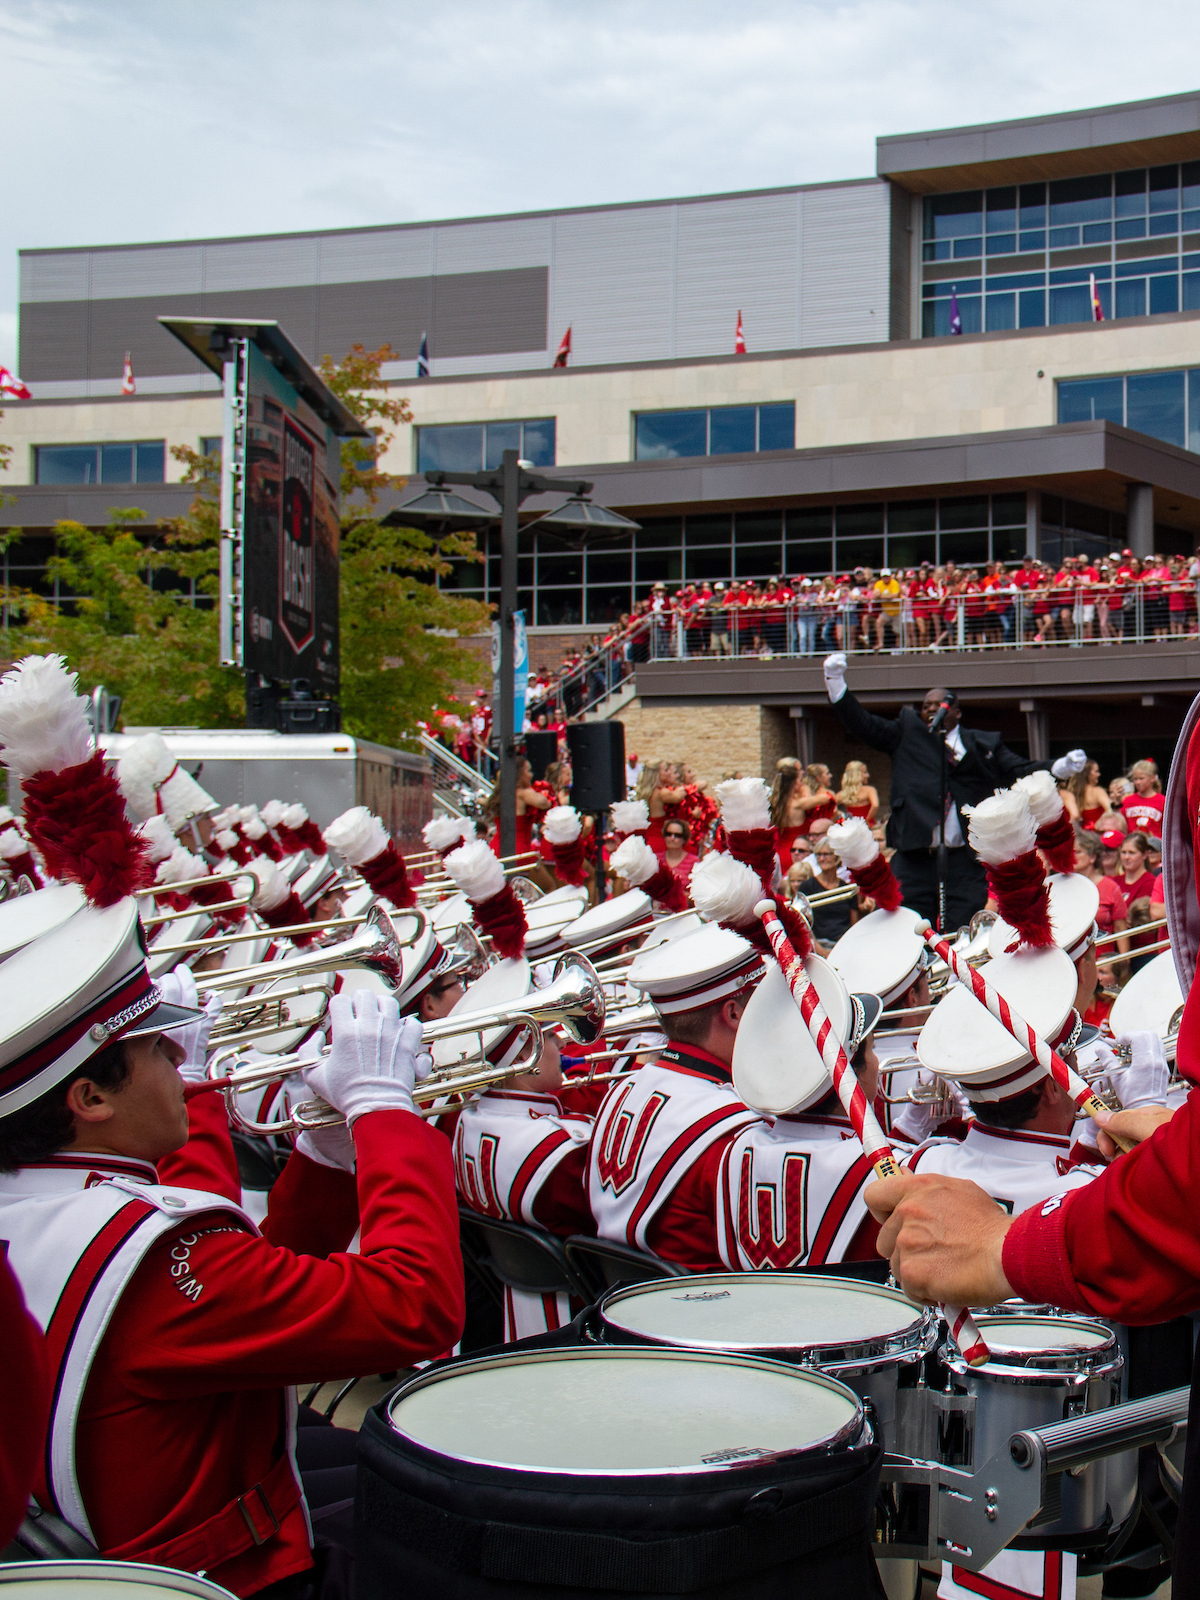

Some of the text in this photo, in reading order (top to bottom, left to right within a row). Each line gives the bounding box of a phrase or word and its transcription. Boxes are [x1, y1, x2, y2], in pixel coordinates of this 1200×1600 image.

[597, 1081, 671, 1198] W
[171, 1227, 243, 1302] WISCO
[737, 1146, 811, 1270] W
